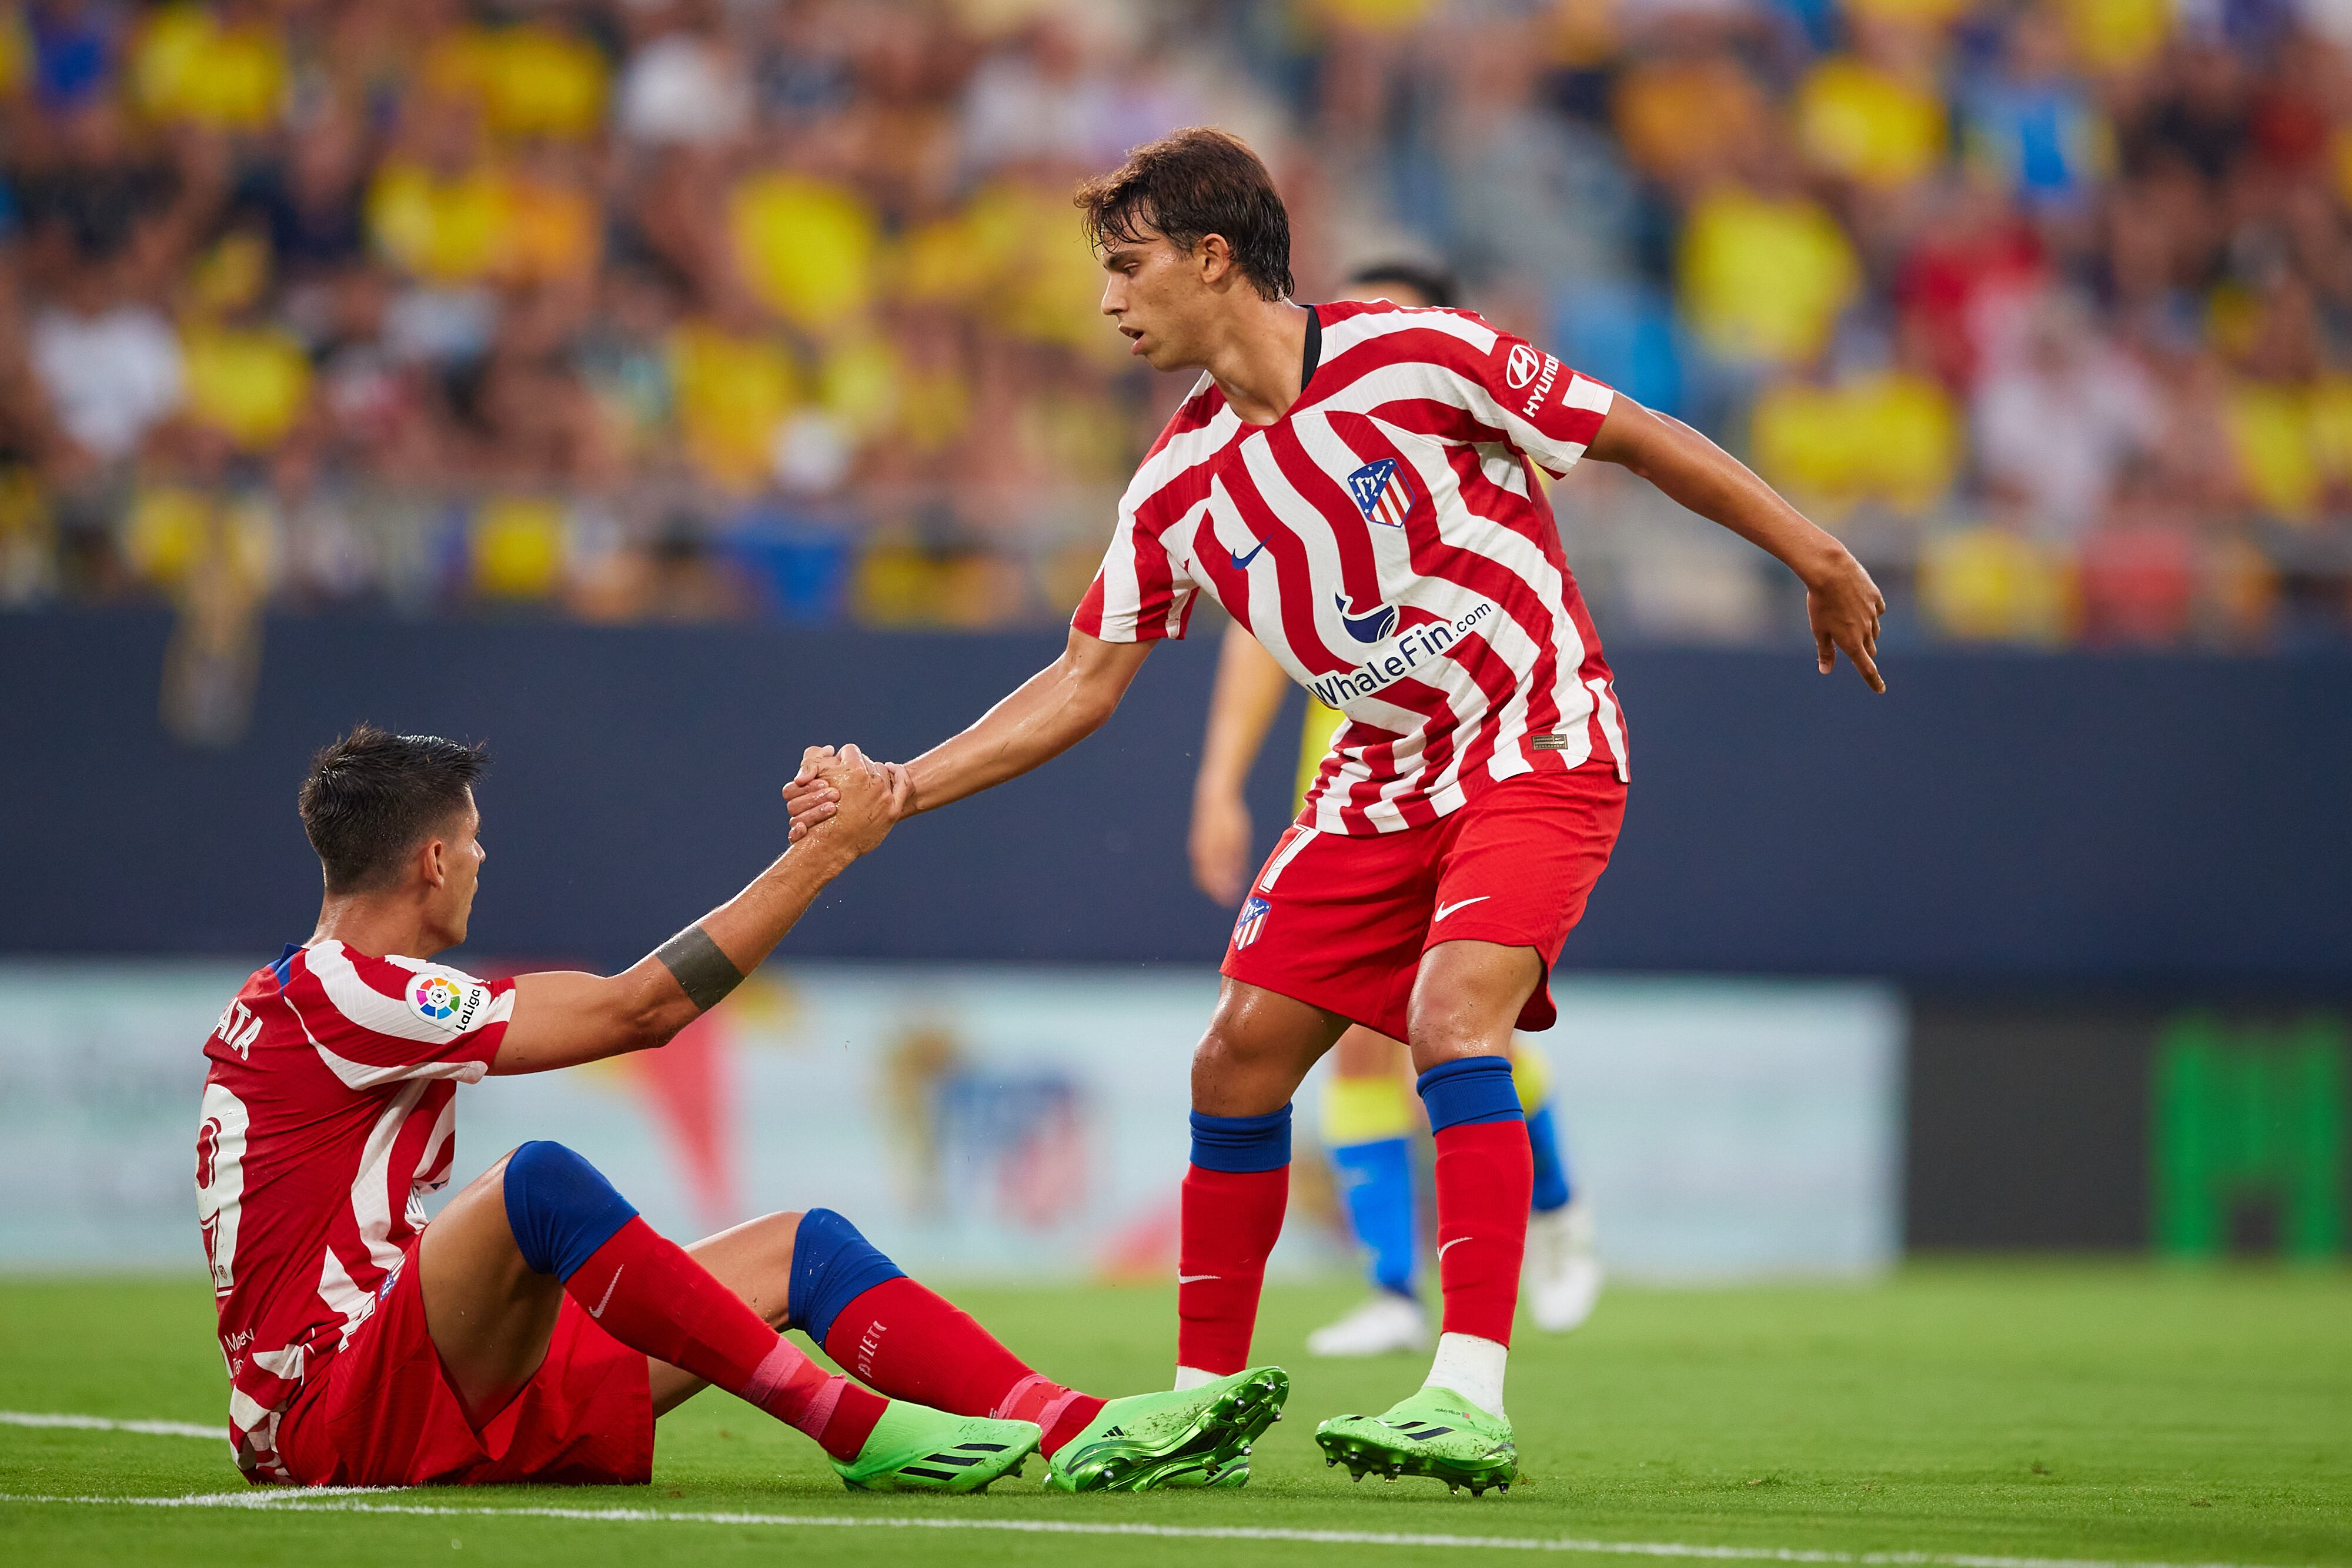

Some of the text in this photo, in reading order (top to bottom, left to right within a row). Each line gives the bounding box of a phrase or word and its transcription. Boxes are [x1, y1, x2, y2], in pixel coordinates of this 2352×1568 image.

[1306, 603, 1492, 706] WhaleFin.com
[455, 988, 481, 1031] LaLiga
[195, 1083, 250, 1298] 9
